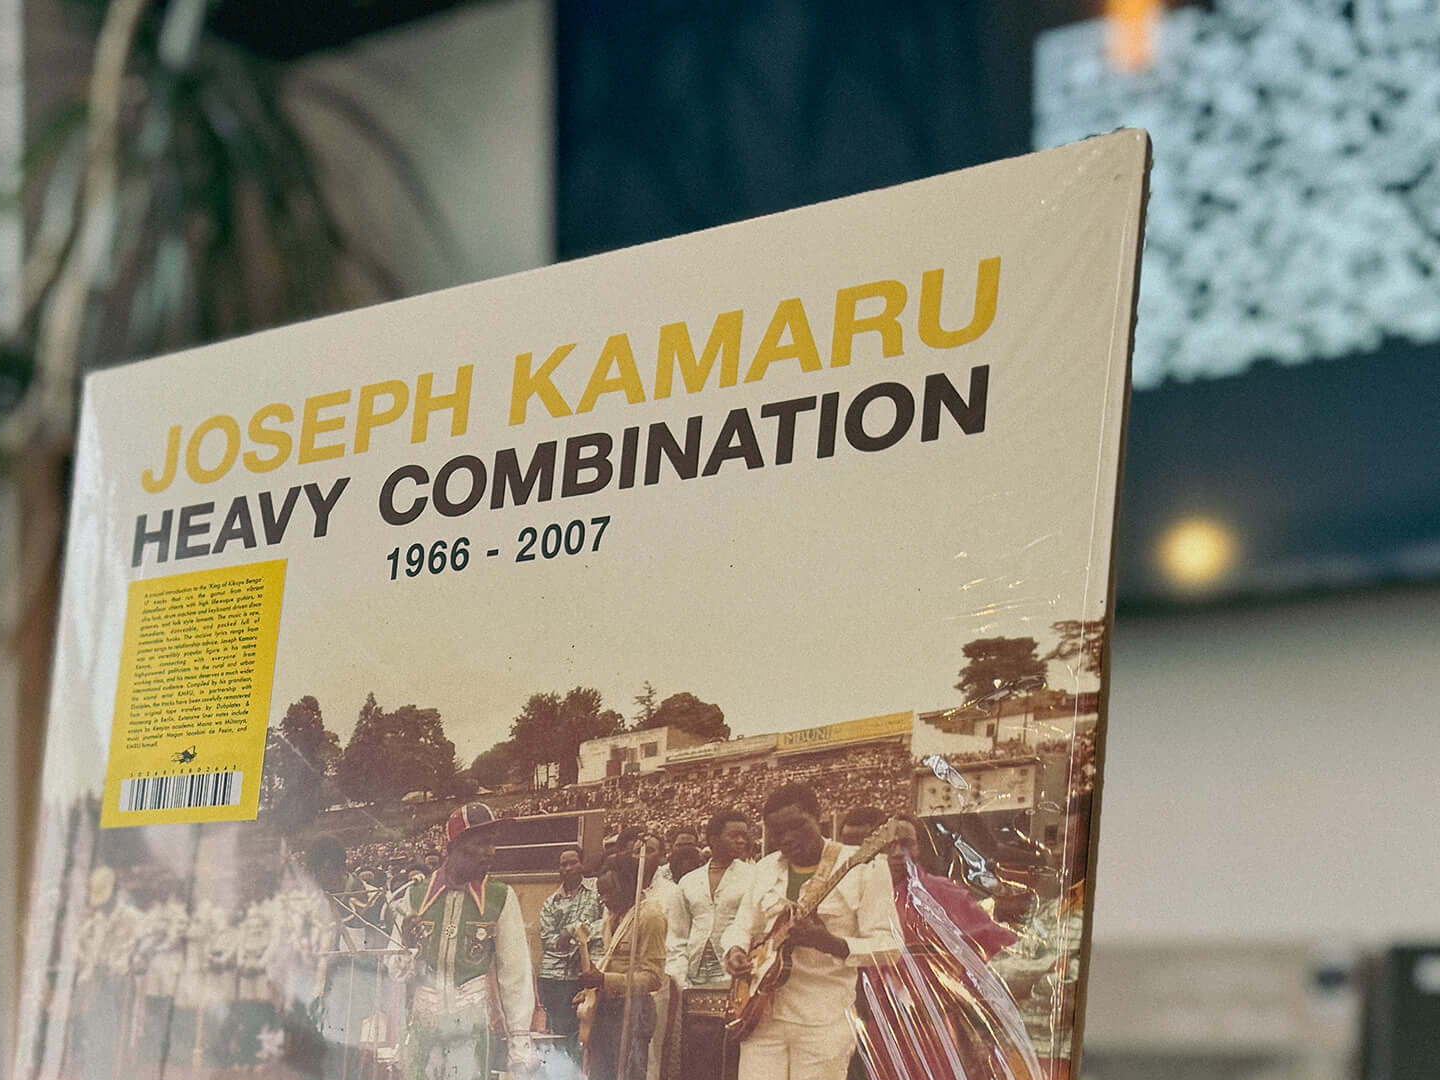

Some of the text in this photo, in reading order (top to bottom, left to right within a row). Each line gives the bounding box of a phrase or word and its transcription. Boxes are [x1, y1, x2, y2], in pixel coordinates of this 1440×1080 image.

[133, 365, 989, 566] HEAVY COMBINATION
[143, 257, 1001, 492] JOSEPH KAMARU
[387, 537, 470, 580] 1966
[516, 516, 610, 563] 2007
